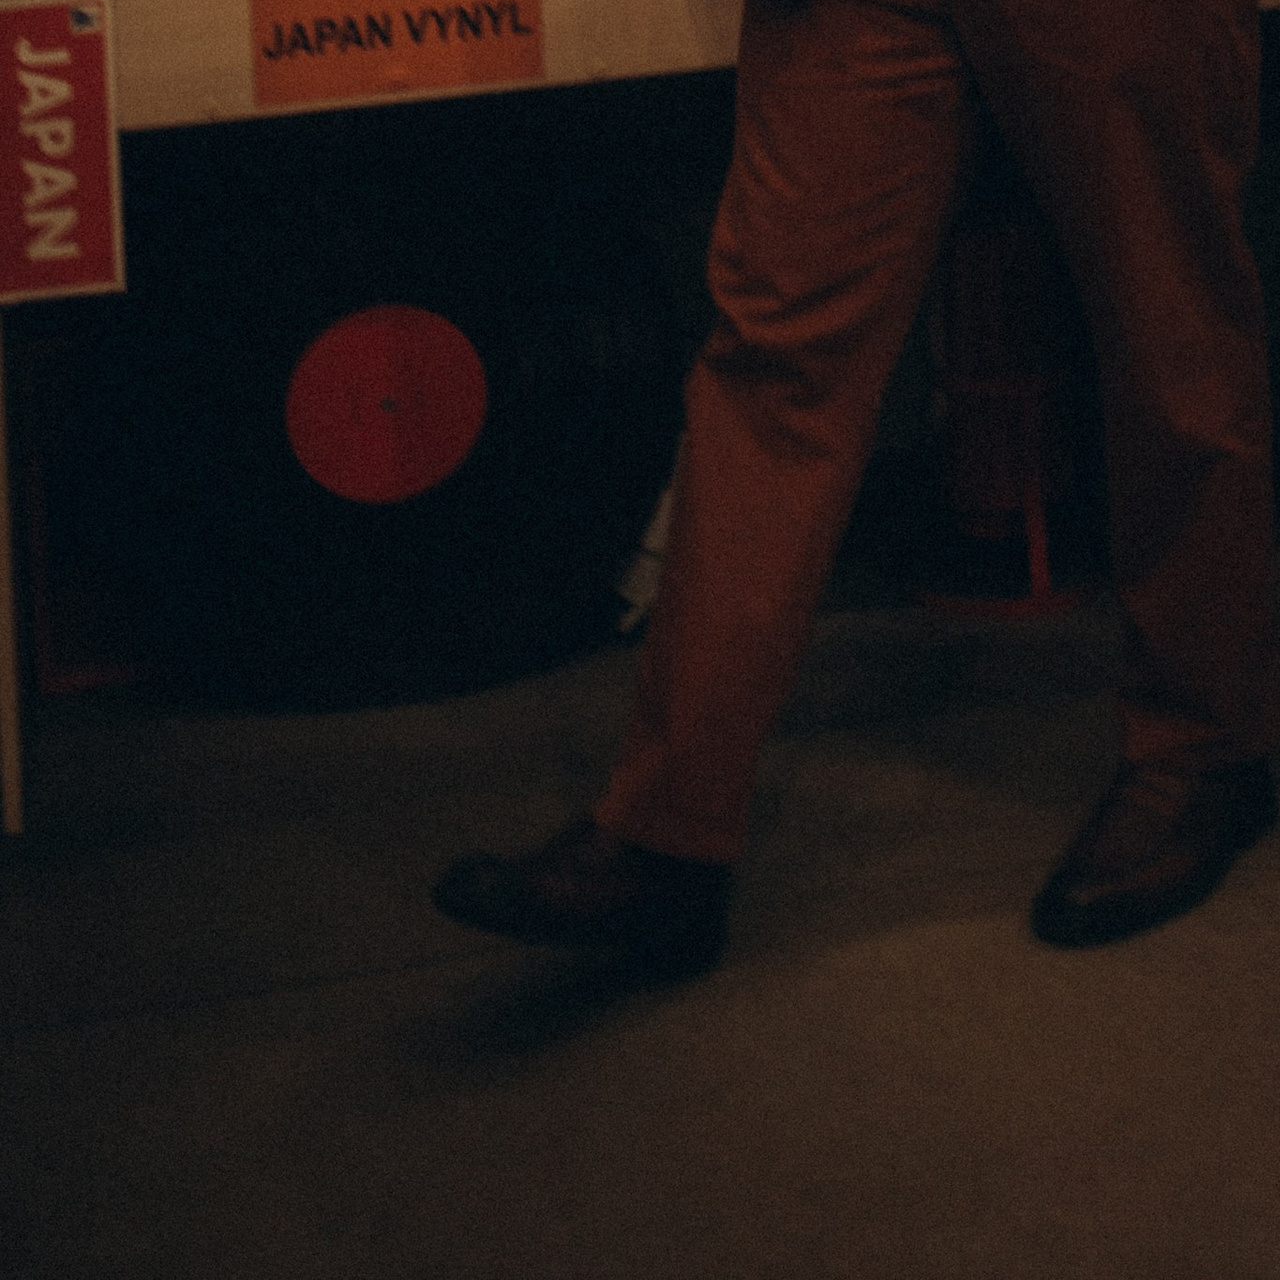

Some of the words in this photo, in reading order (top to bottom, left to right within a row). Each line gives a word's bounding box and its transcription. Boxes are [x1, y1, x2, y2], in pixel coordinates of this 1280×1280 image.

[262, 12, 393, 62] JAPAN
[403, 0, 533, 44] VYNYL
[14, 38, 82, 263] JAPAN
